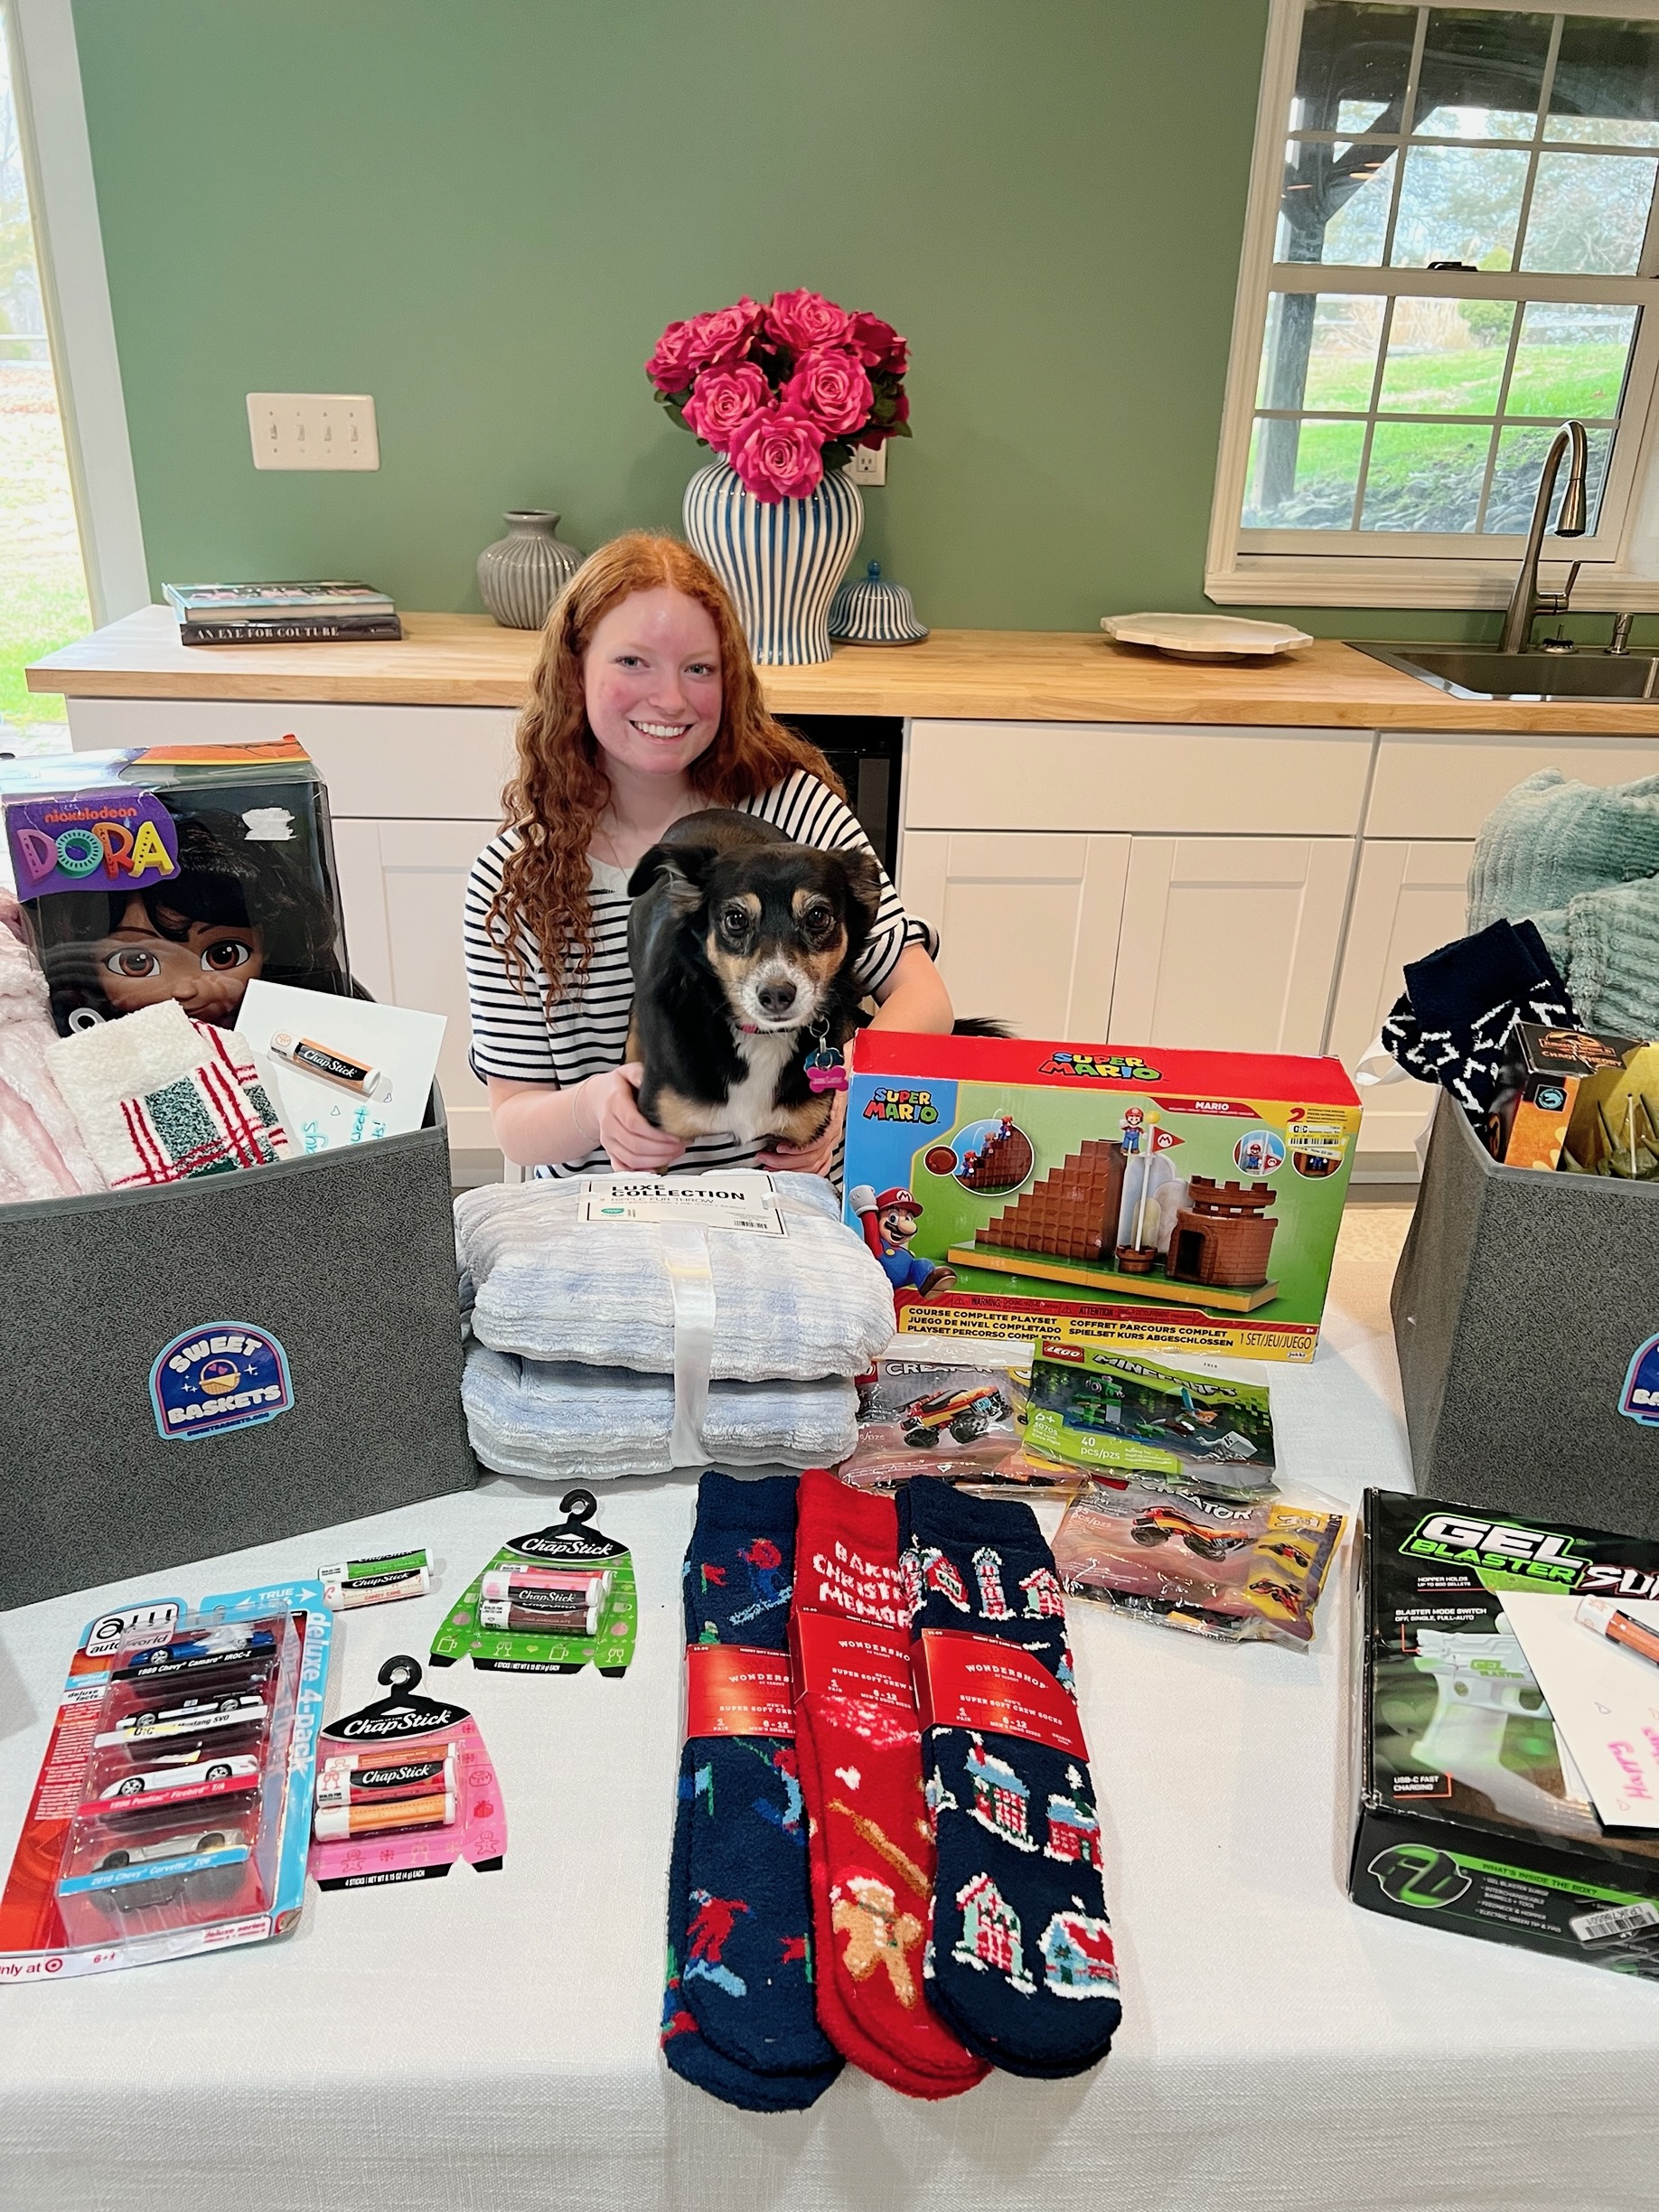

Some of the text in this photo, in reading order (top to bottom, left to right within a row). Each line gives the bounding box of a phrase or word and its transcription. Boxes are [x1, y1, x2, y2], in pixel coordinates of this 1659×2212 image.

[196, 625, 340, 639] AN EYE FOR COUTURE
[44, 806, 137, 823] nickelodeon
[16, 820, 175, 884] DORA
[304, 1050, 356, 1077] ChapStick
[1052, 1051, 1146, 1067] SUPER
[1037, 1059, 1163, 1083] MARIO
[874, 1086, 932, 1105] SUPER
[862, 1101, 940, 1125] MARIO
[1195, 1101, 1230, 1111] MARIO
[612, 1190, 745, 1200] COLLECTION
[908, 1308, 1058, 1325] COURSE COMPLETE PLAYSET
[907, 1325, 1006, 1338] PLAYSET PERCORSO
[908, 1317, 942, 1325] JUEGO
[960, 1320, 990, 1328] NIVEL
[992, 1322, 1062, 1334] COMPLETADO
[1070, 1319, 1228, 1337] COFFRET PARCOURS COMPLET
[1069, 1327, 1233, 1347] SPIELSET KURS ABGESCHLOSSEN
[1239, 1333, 1311, 1350] 1 SET/JEU/JUEGO
[168, 1336, 263, 1373] SWEET
[1045, 1345, 1083, 1357] LEGO
[167, 1384, 282, 1424] BASKETS
[1035, 1411, 1055, 1424] 6+
[1081, 1437, 1096, 1447] 40
[1081, 1447, 1120, 1460] pcs/pzs
[520, 1538, 613, 1556] ChapStick
[1422, 1515, 1584, 1570] GEL
[1410, 1538, 1578, 1583] BLASTER
[352, 1572, 409, 1588] ChapStick
[813, 1552, 904, 1603] CHRIST
[1580, 1566, 1659, 1601] SU
[258, 1588, 295, 1599] TRUE
[364, 1592, 385, 1600] CANDY
[518, 1589, 576, 1603] ChapStick
[819, 1581, 913, 1629] MEMOR
[1395, 1608, 1431, 1617] BLASTER
[301, 1612, 332, 1682] deluxe
[838, 1640, 911, 1662] WONDERSHO
[137, 1650, 252, 1676] 1989 Chevy Camaro IROC-Z
[728, 1673, 790, 1683] WONDERS
[830, 1679, 839, 1687] 1
[831, 1667, 907, 1689] SUPER SOFT CREW
[964, 1664, 1046, 1690] WONDERSHOP
[959, 1707, 967, 1717] 1
[960, 1694, 1064, 1726] SUPER SOFT CREW SOCKS
[212, 1714, 230, 1724] SVO
[343, 1709, 450, 1736] ChapStick
[717, 1718, 725, 1727] 1
[1016, 1720, 1027, 1729] 12
[361, 1764, 430, 1785] ChapStick
[1393, 1776, 1419, 1784] USB-C
[1393, 1784, 1434, 1792] CHARGING
[91, 1857, 211, 1886] 2010 Chevy Corvette Z06
[345, 1870, 426, 1887] 4 STICKS NET WT OZ EACH
[1482, 1863, 1598, 1896] WHAT'S INSIDE THE BOX?
[237, 1921, 267, 1933] series
[1508, 1916, 1530, 1926] GREEN
[26, 1964, 41, 1974] at
